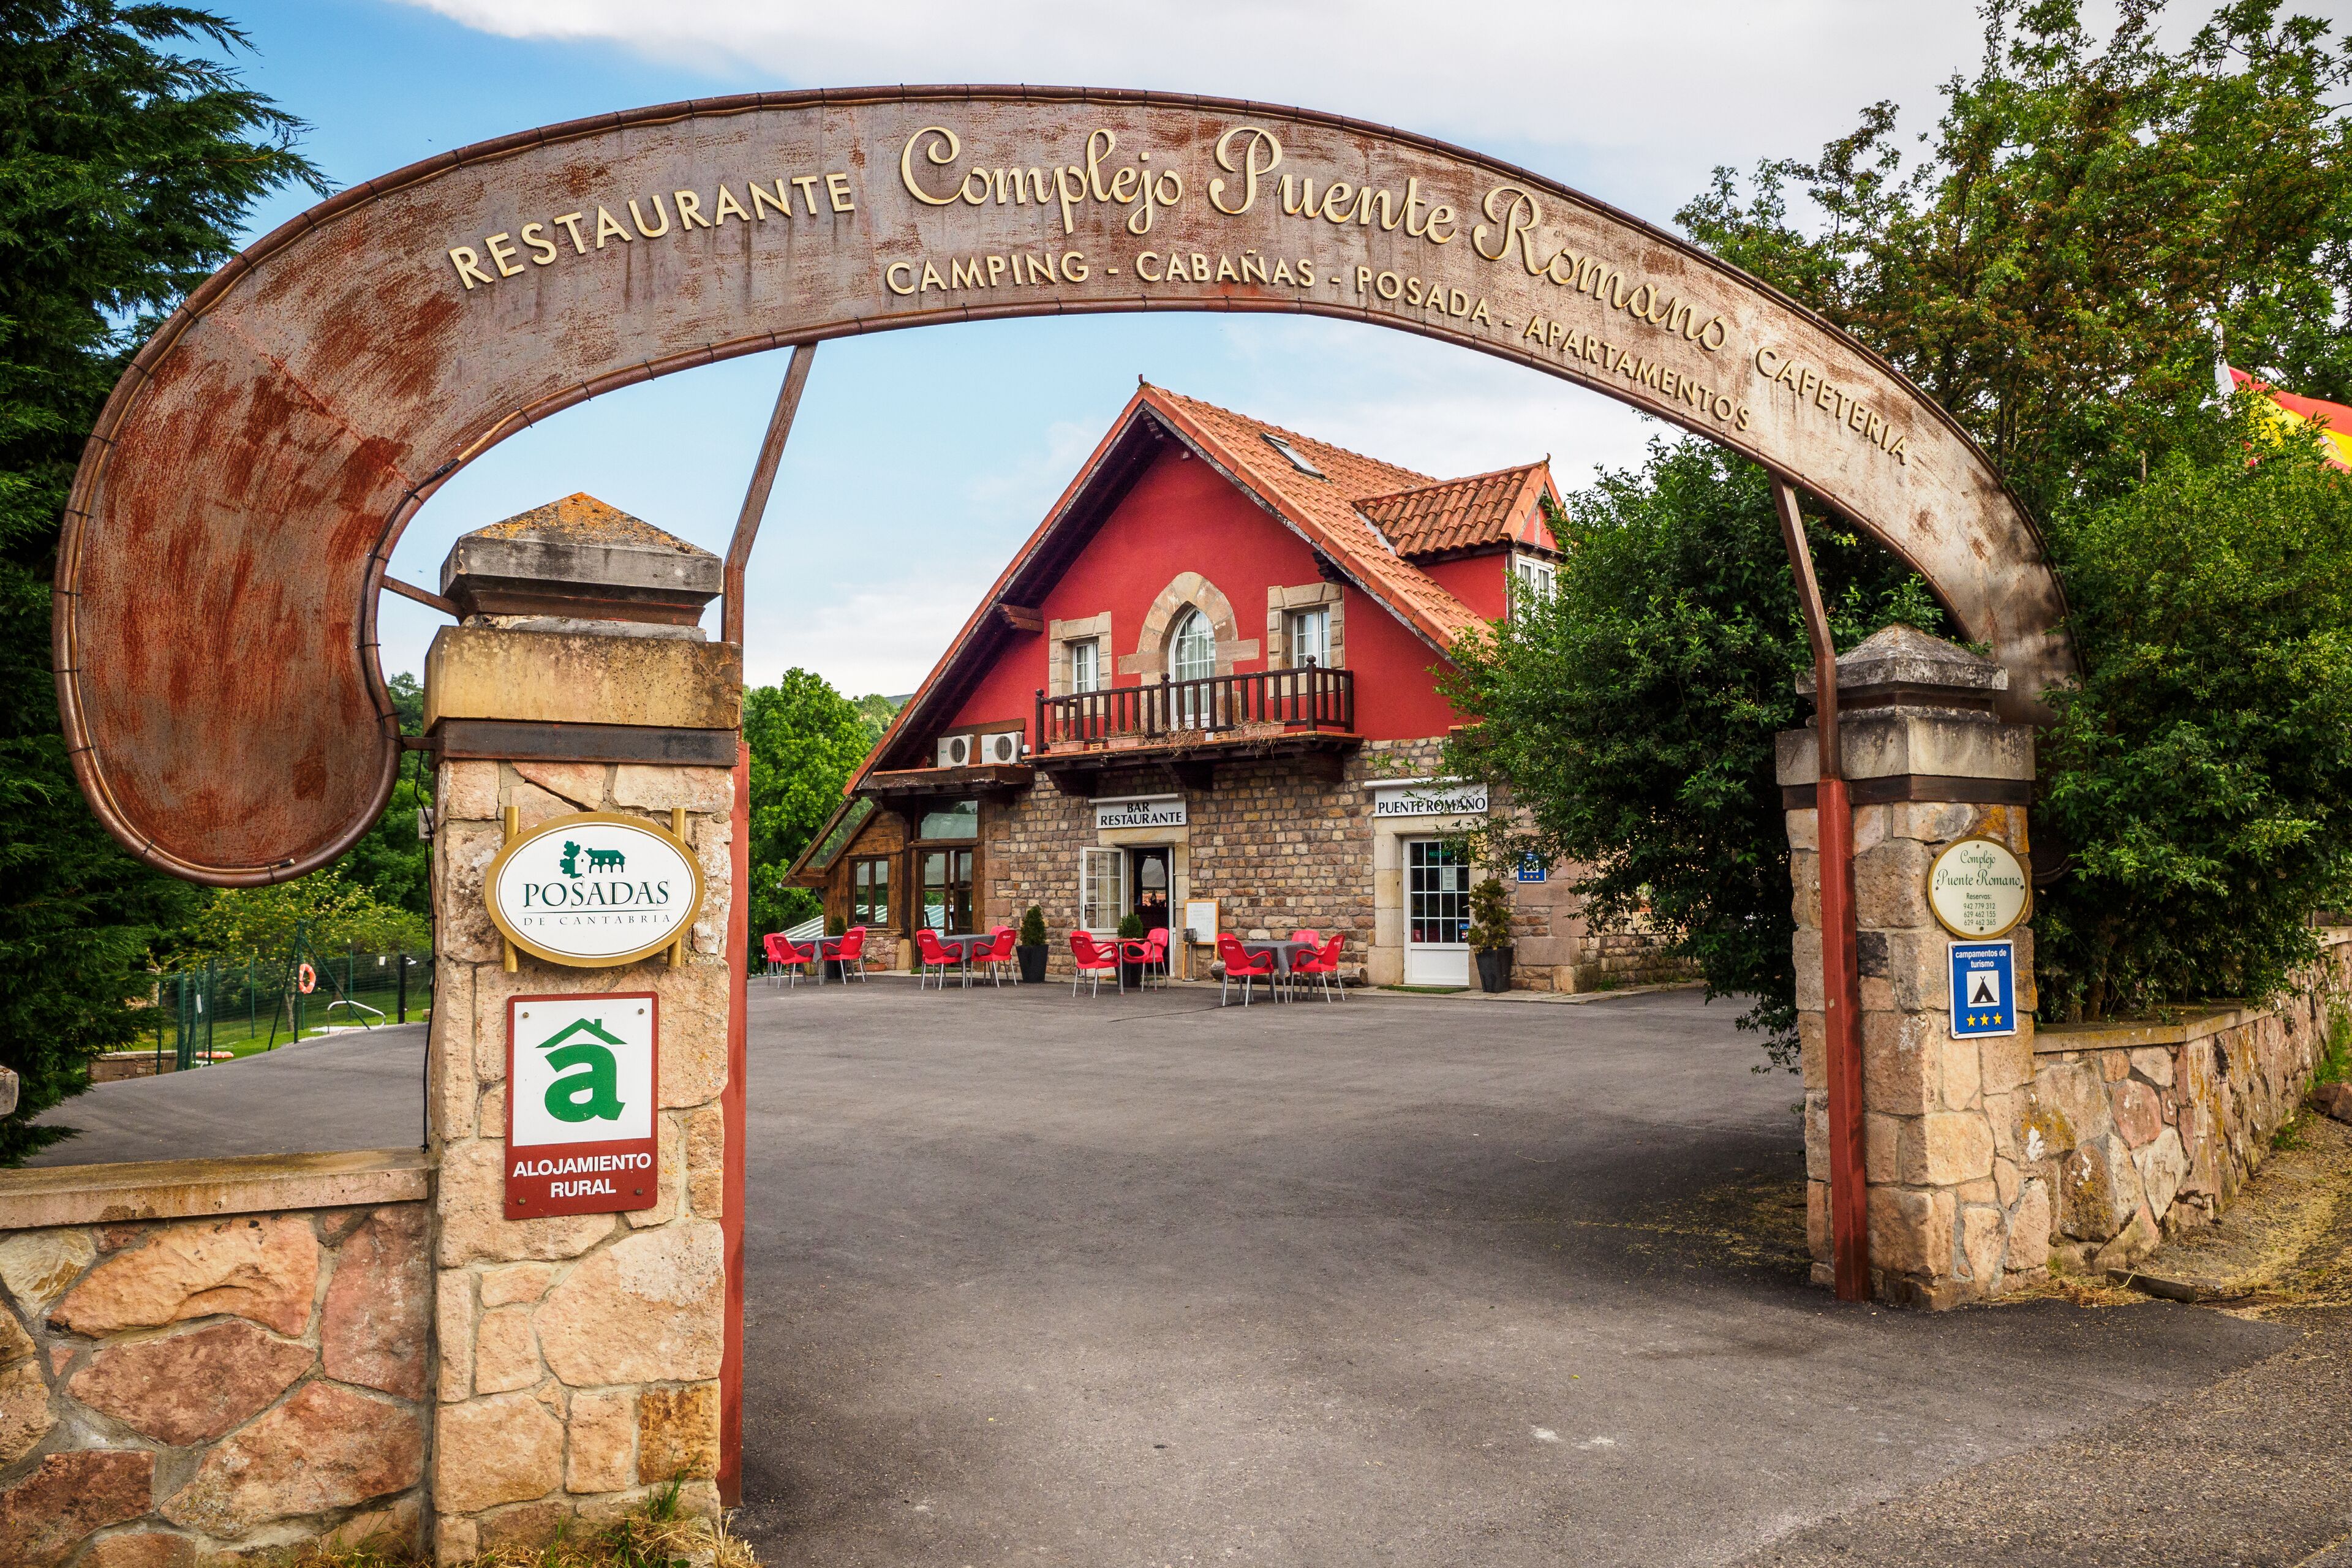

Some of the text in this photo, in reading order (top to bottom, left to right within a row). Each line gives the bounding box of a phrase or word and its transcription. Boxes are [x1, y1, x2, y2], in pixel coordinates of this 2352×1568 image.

[448, 173, 855, 290] RESTAURANTE
[900, 126, 1728, 351] Complejo Puente Romano
[886, 251, 1089, 295] CAMPING
[1136, 249, 1315, 288] CABAÑAS
[1355, 265, 1491, 326] POSADA
[1523, 315, 1751, 432] APARTAMENTOS
[1755, 346, 1909, 466] CAFETERIA
[1127, 801, 1150, 813] BAR
[1378, 797, 1486, 813] PUENTE ROMANO
[1101, 812, 1182, 826] RESTAURANTE
[1960, 850, 1996, 869] Complejo
[1937, 869, 2021, 886] Puente Romano
[522, 880, 671, 908] POSADAS
[524, 914, 671, 925] DE CANTABRIA
[1955, 949, 1998, 959] campamentos
[513, 1153, 651, 1177] ALOJAMIENTO
[551, 1178, 616, 1198] RURAL
